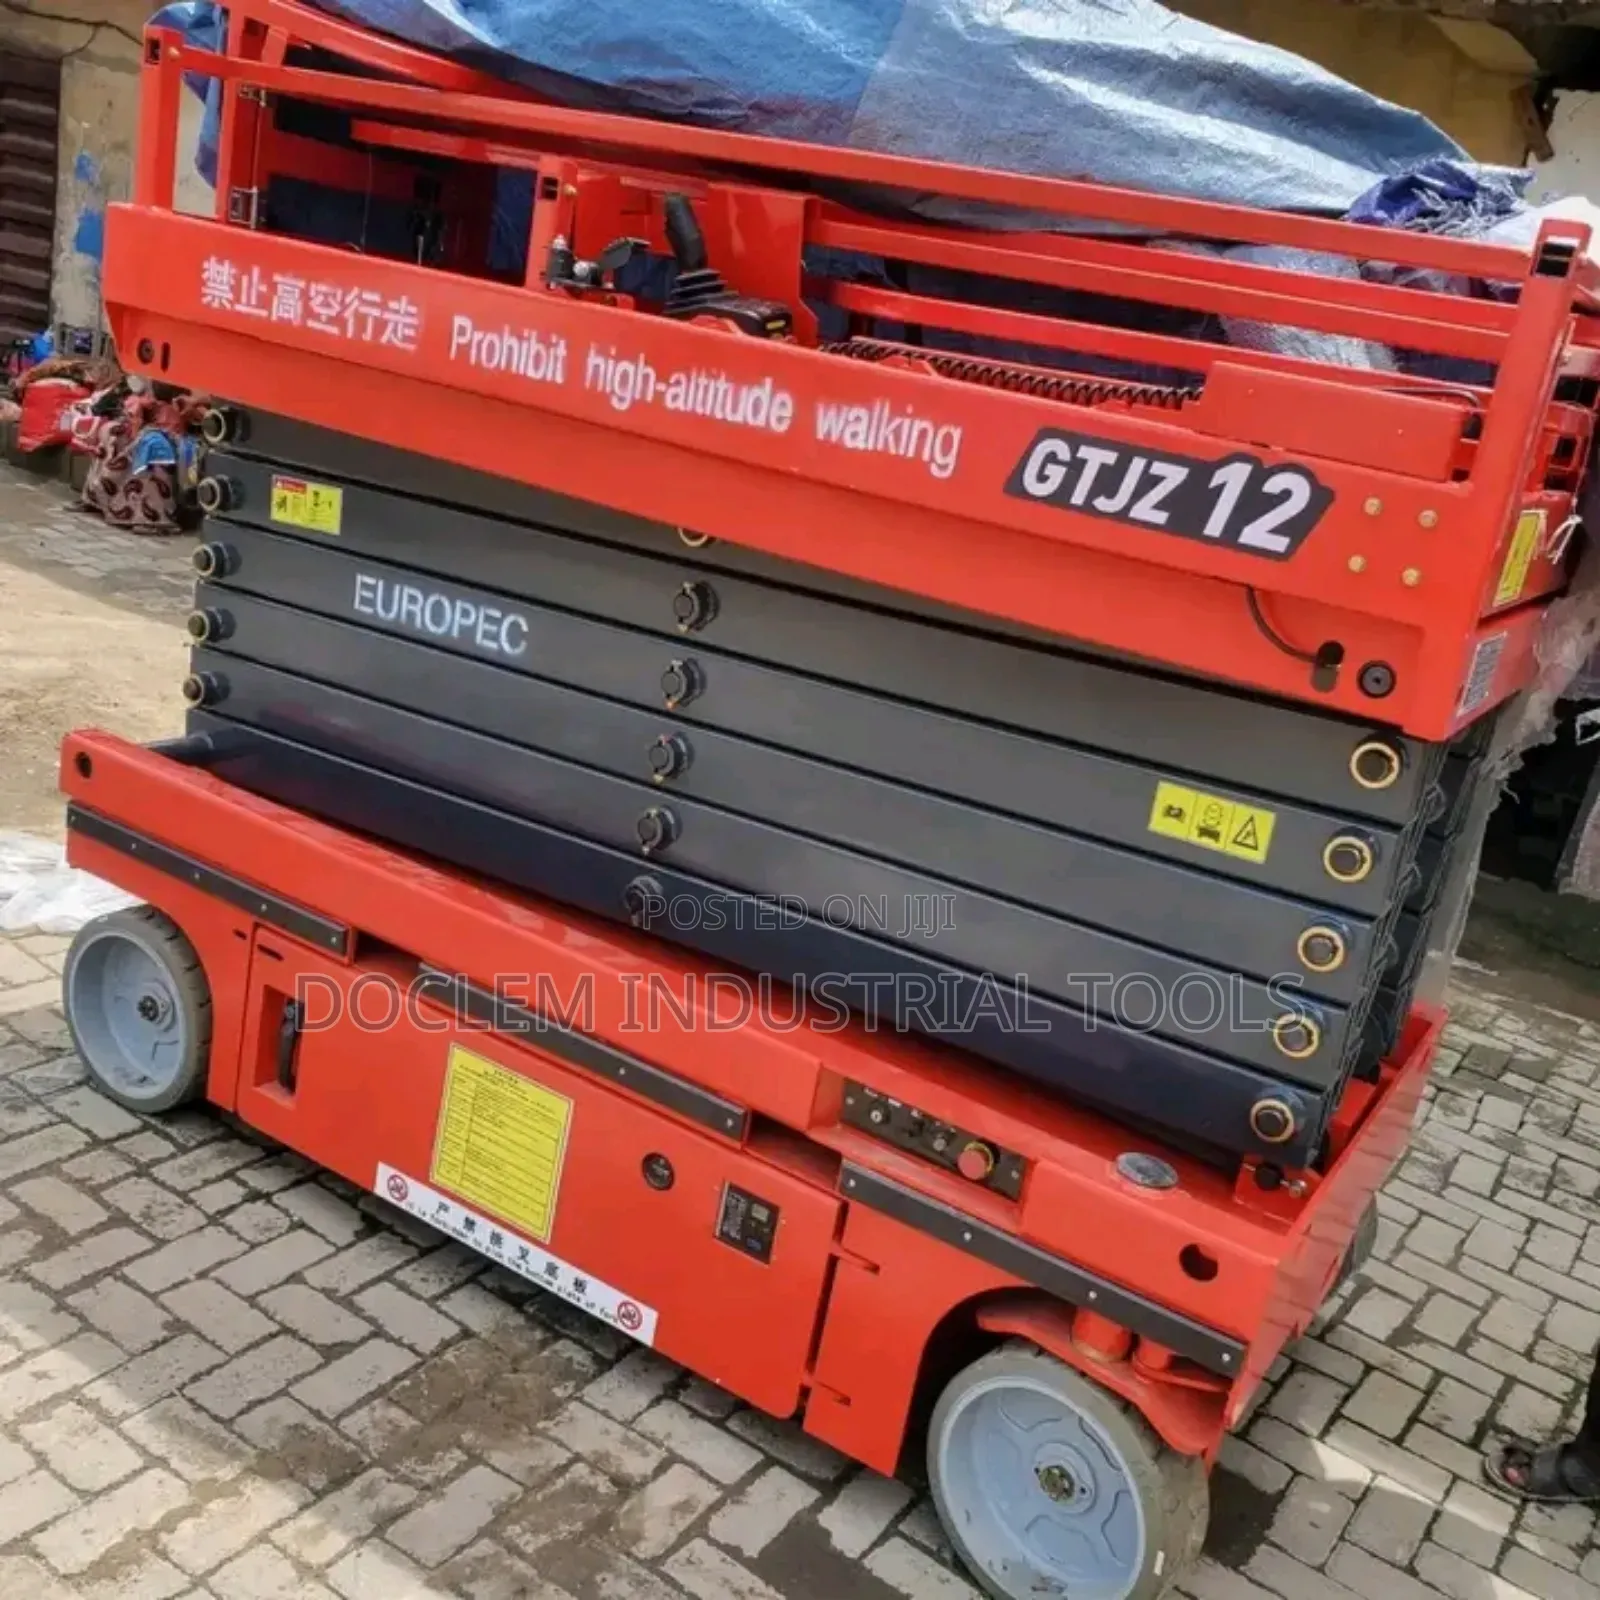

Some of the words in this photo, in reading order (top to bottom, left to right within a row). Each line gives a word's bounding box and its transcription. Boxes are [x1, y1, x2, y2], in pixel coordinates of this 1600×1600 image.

[201, 256, 419, 352] 禁止高空行走
[448, 315, 567, 384] Prohibit
[584, 341, 793, 433] high-altitude
[814, 398, 964, 478] walking
[1022, 437, 1190, 525] GTJZ
[1203, 462, 1312, 553] 12
[353, 573, 529, 656] EUROPEC
